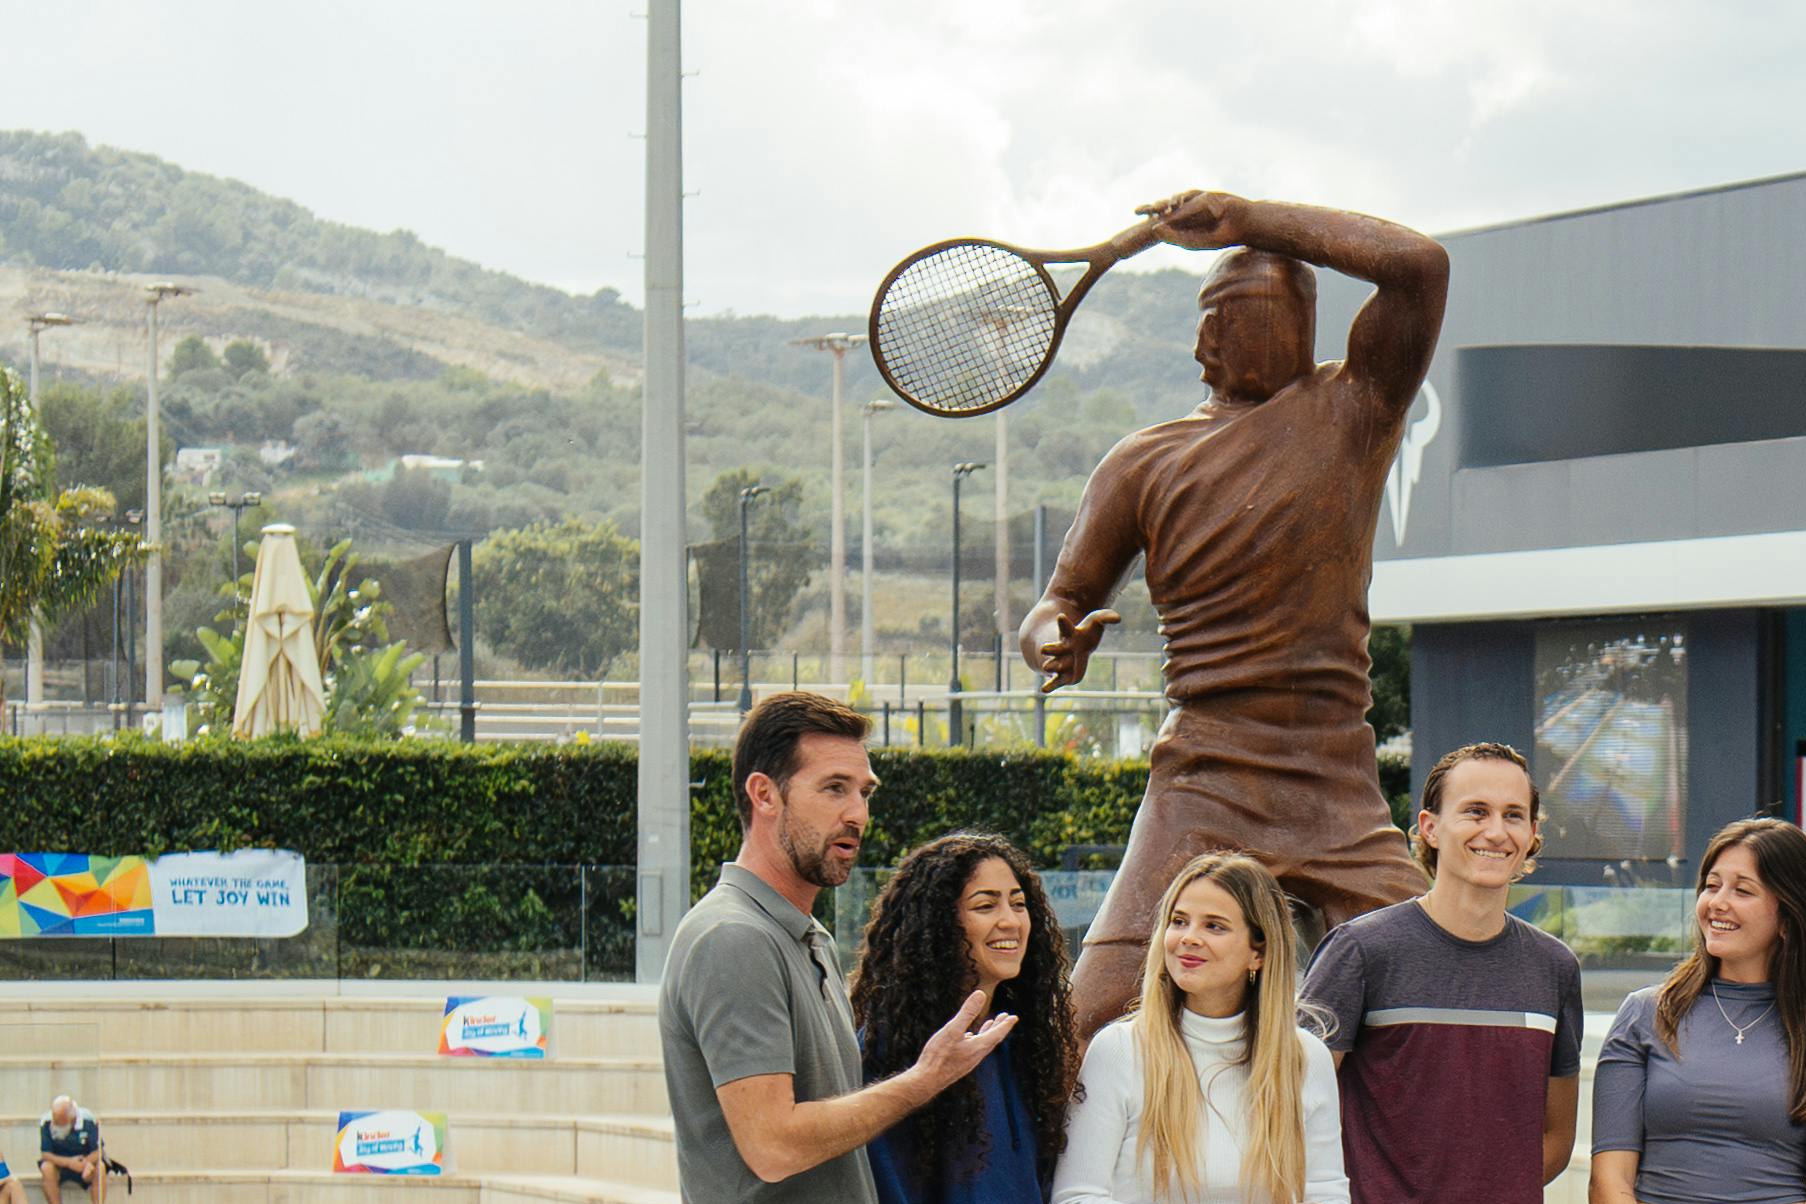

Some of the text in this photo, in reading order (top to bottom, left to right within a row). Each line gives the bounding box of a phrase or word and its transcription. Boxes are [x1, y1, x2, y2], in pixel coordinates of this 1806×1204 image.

[170, 876, 227, 887] WHATEVER
[233, 878, 252, 888] THE
[171, 889, 290, 906] LET JOY WIN
